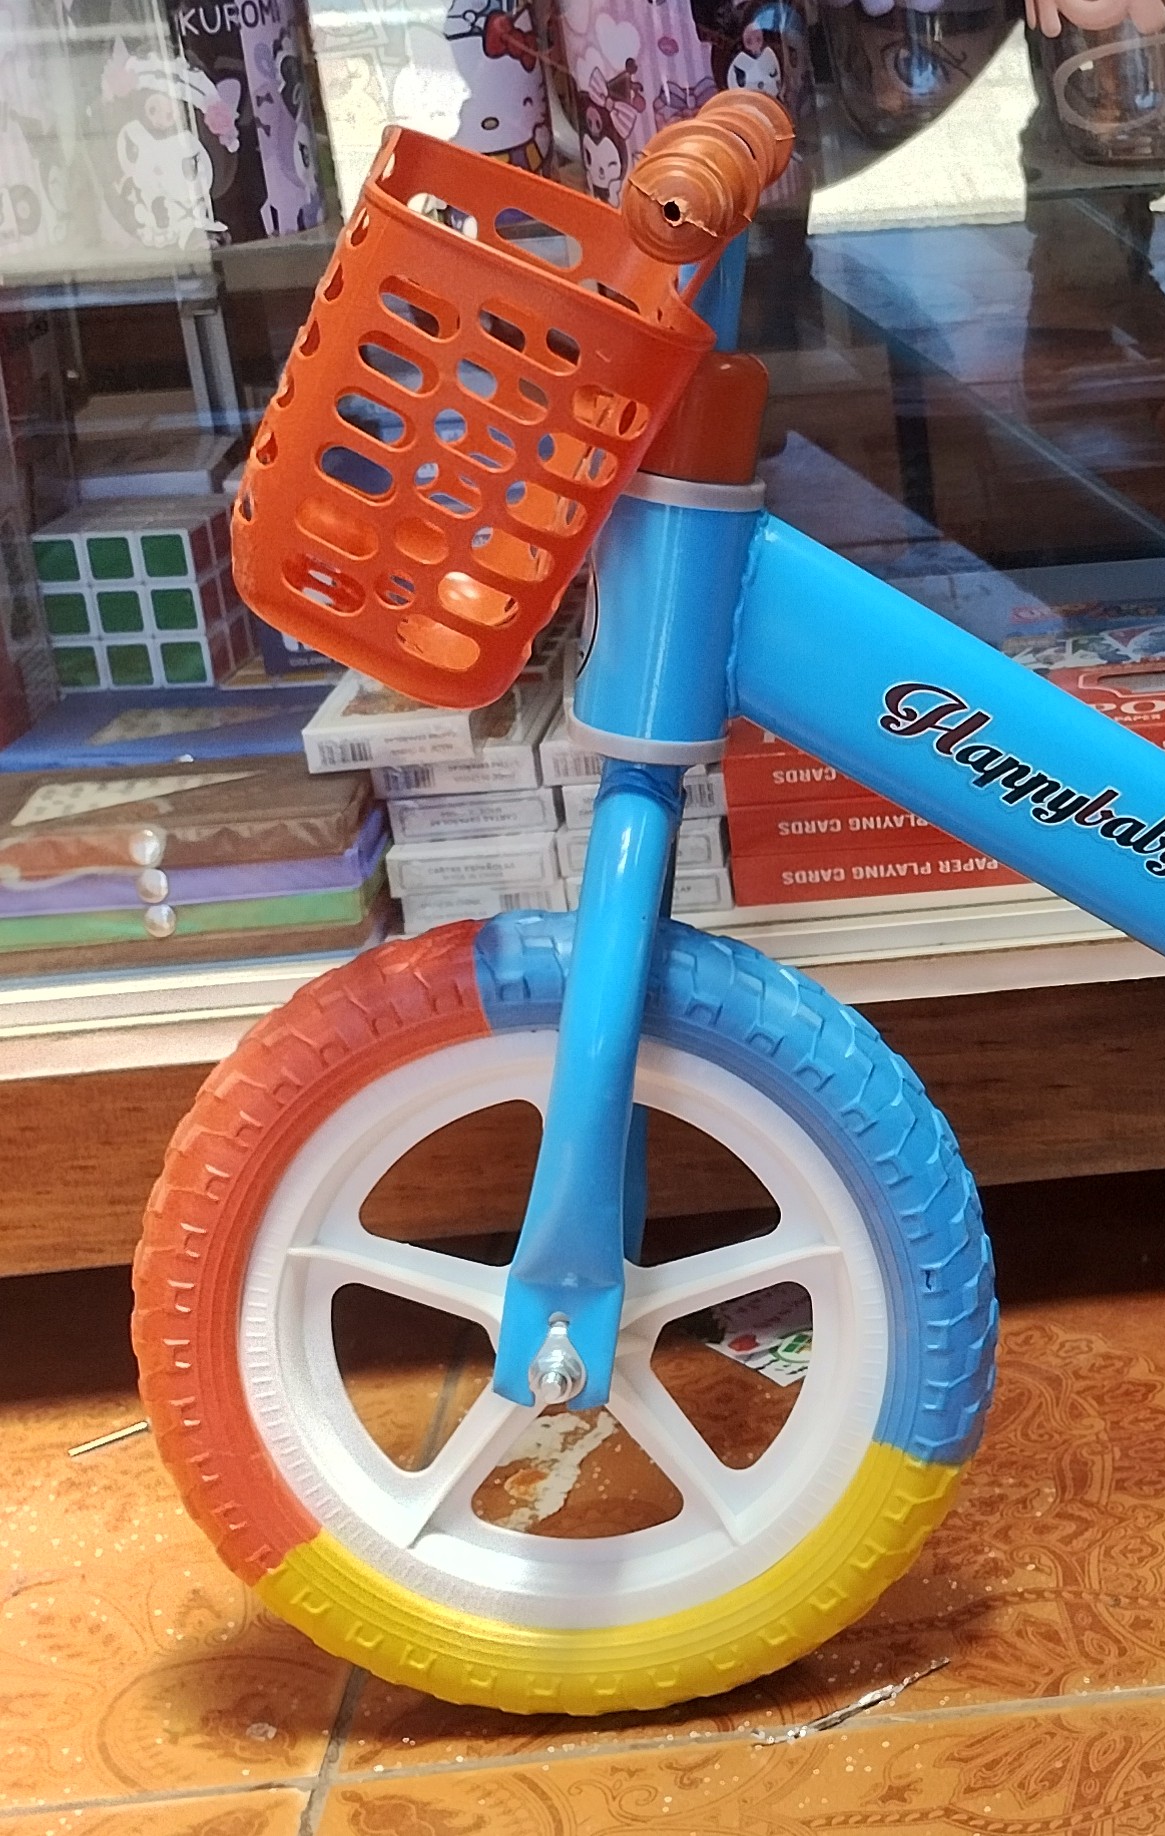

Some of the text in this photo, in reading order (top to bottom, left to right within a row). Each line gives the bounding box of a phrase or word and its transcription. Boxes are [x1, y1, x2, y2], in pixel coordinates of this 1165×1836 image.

[773, 765, 837, 784] CARDS
[779, 813, 928, 836] PLAYING CARDS
[782, 857, 998, 886] PAPER PLAYING CARDS
